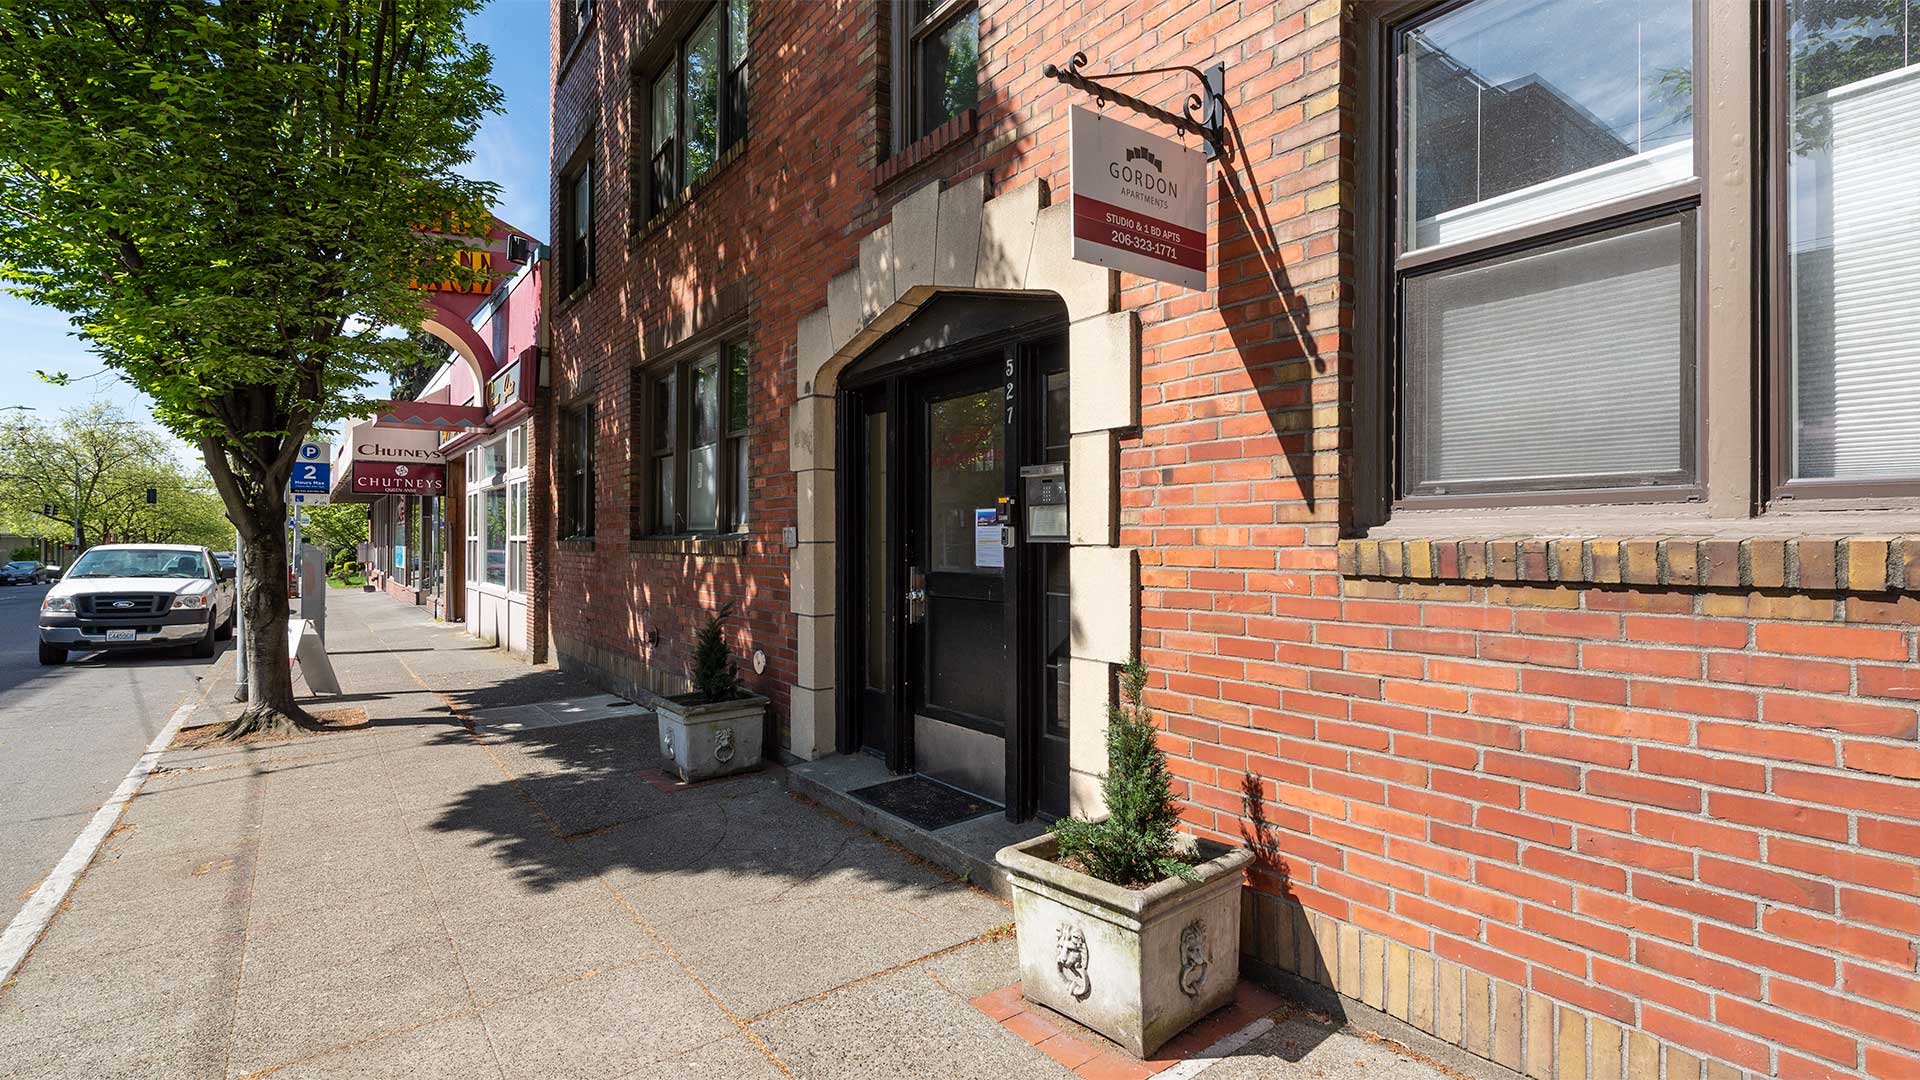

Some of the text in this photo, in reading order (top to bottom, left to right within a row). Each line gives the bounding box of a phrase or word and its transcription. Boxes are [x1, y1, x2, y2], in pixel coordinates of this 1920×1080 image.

[1109, 162, 1178, 198] GORDON
[1120, 187, 1169, 210] APARTMENTS
[1106, 212, 1181, 243] STUDIO & 1 BD APTS
[1111, 230, 1177, 259] 206-323-1771
[306, 447, 316, 457] P
[303, 465, 317, 480] 2
[357, 476, 442, 489] CHUTNEYS
